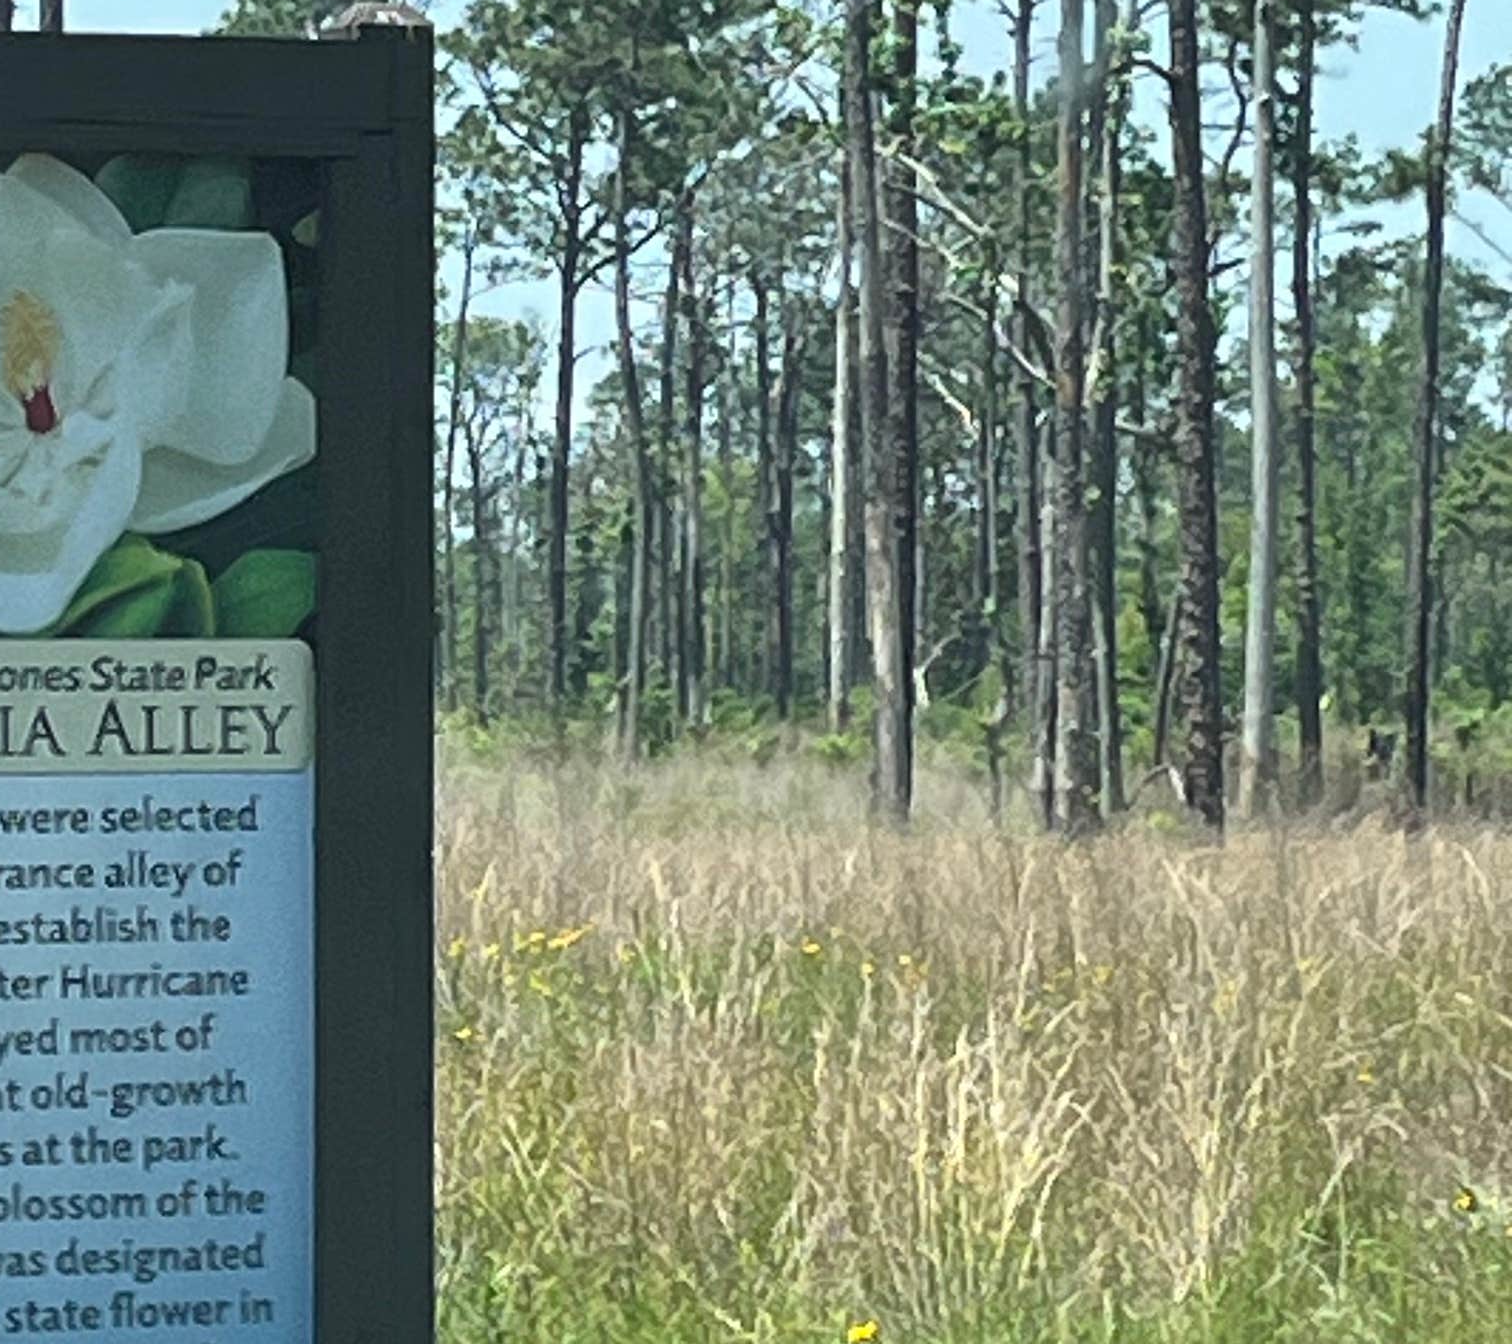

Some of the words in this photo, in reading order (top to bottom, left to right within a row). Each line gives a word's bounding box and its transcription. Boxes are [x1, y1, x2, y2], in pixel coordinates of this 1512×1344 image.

[88, 656, 186, 691] State
[194, 654, 276, 690] Park
[86, 699, 294, 757] ALLEY
[98, 796, 258, 833] selected
[104, 852, 190, 896] alley
[203, 850, 242, 888] of
[169, 906, 231, 942] the
[59, 963, 249, 999] Hurricane
[69, 1019, 166, 1054] most
[176, 1012, 216, 1051] of
[30, 1069, 248, 1117] old-growth
[22, 1134, 63, 1165] at
[71, 1128, 132, 1164] the
[143, 1127, 239, 1171] park.
[157, 1181, 195, 1219] of
[205, 1180, 265, 1216] the
[55, 1234, 265, 1284] designated
[4, 1302, 100, 1333] state
[111, 1291, 228, 1330] flower
[240, 1289, 273, 1325] in
